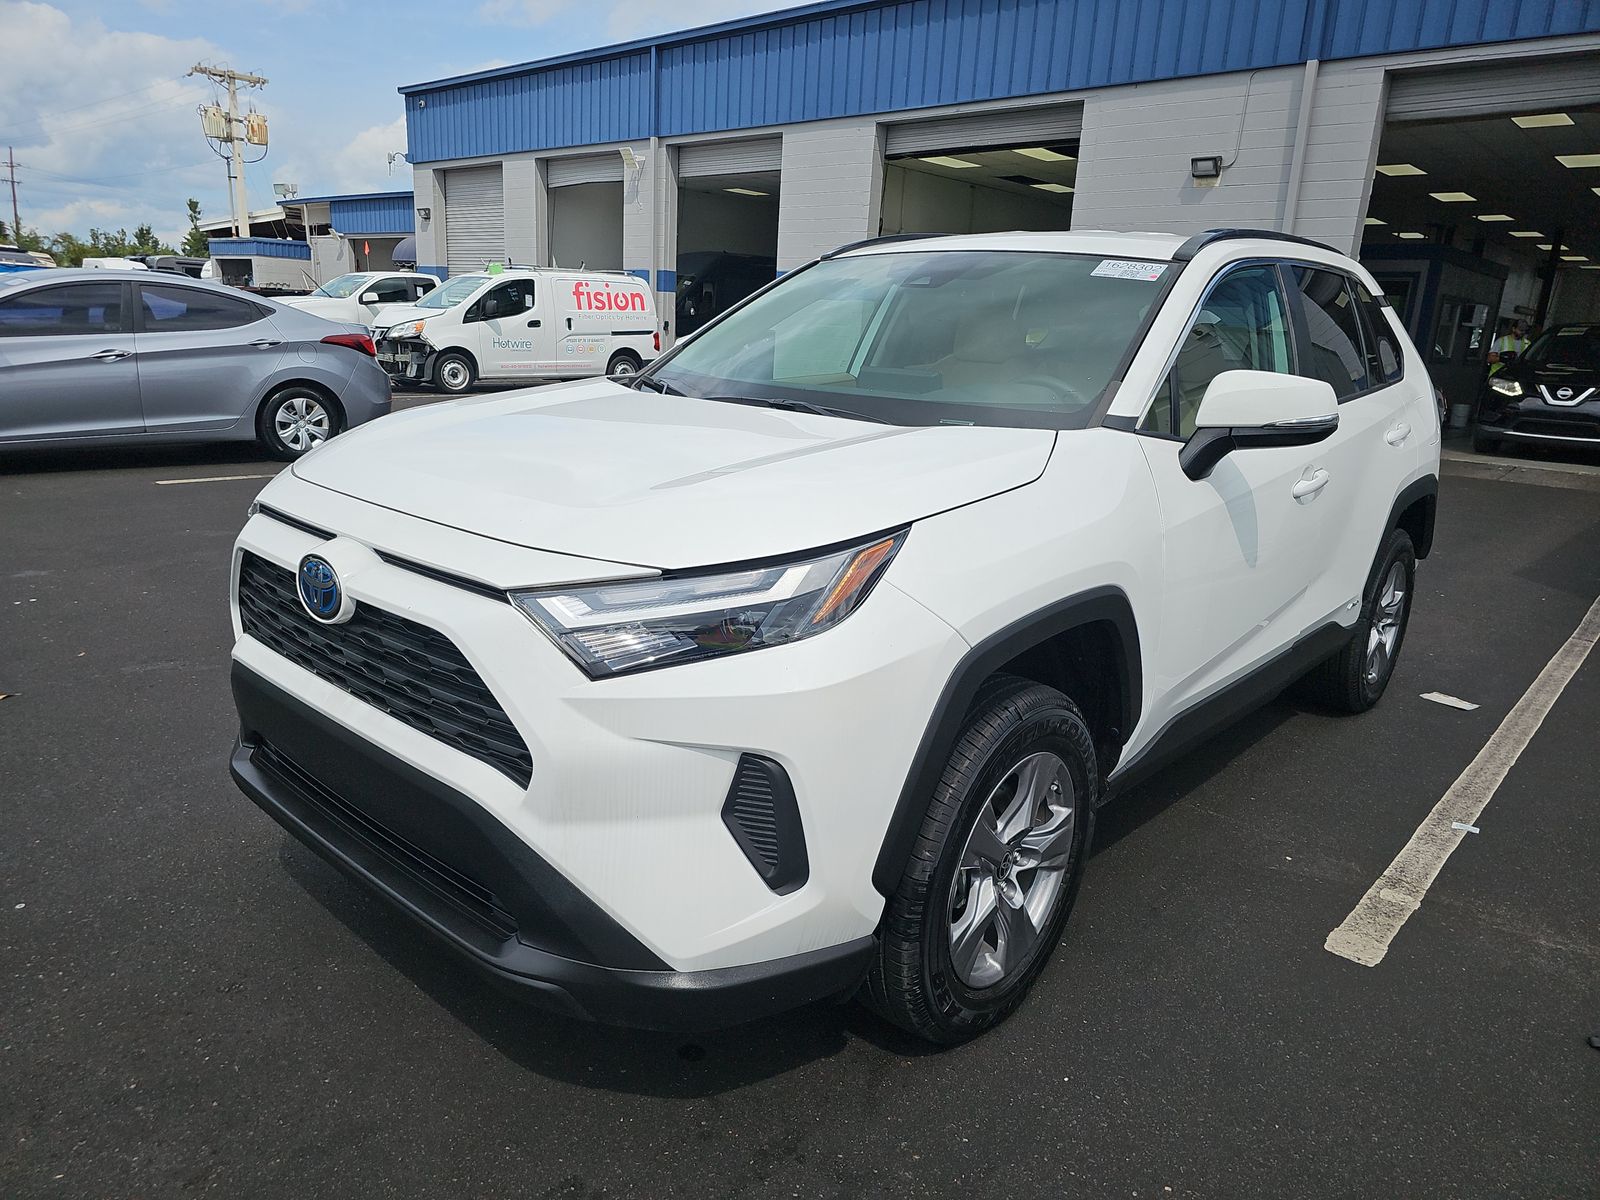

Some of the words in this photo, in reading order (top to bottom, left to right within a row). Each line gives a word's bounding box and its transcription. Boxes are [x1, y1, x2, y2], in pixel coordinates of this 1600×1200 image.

[1105, 261, 1162, 272] 1628302
[572, 281, 646, 311] fision
[578, 313, 594, 322] Fiber
[595, 313, 615, 323] Optics
[616, 314, 624, 323] by
[492, 337, 533, 349] Hotwire
